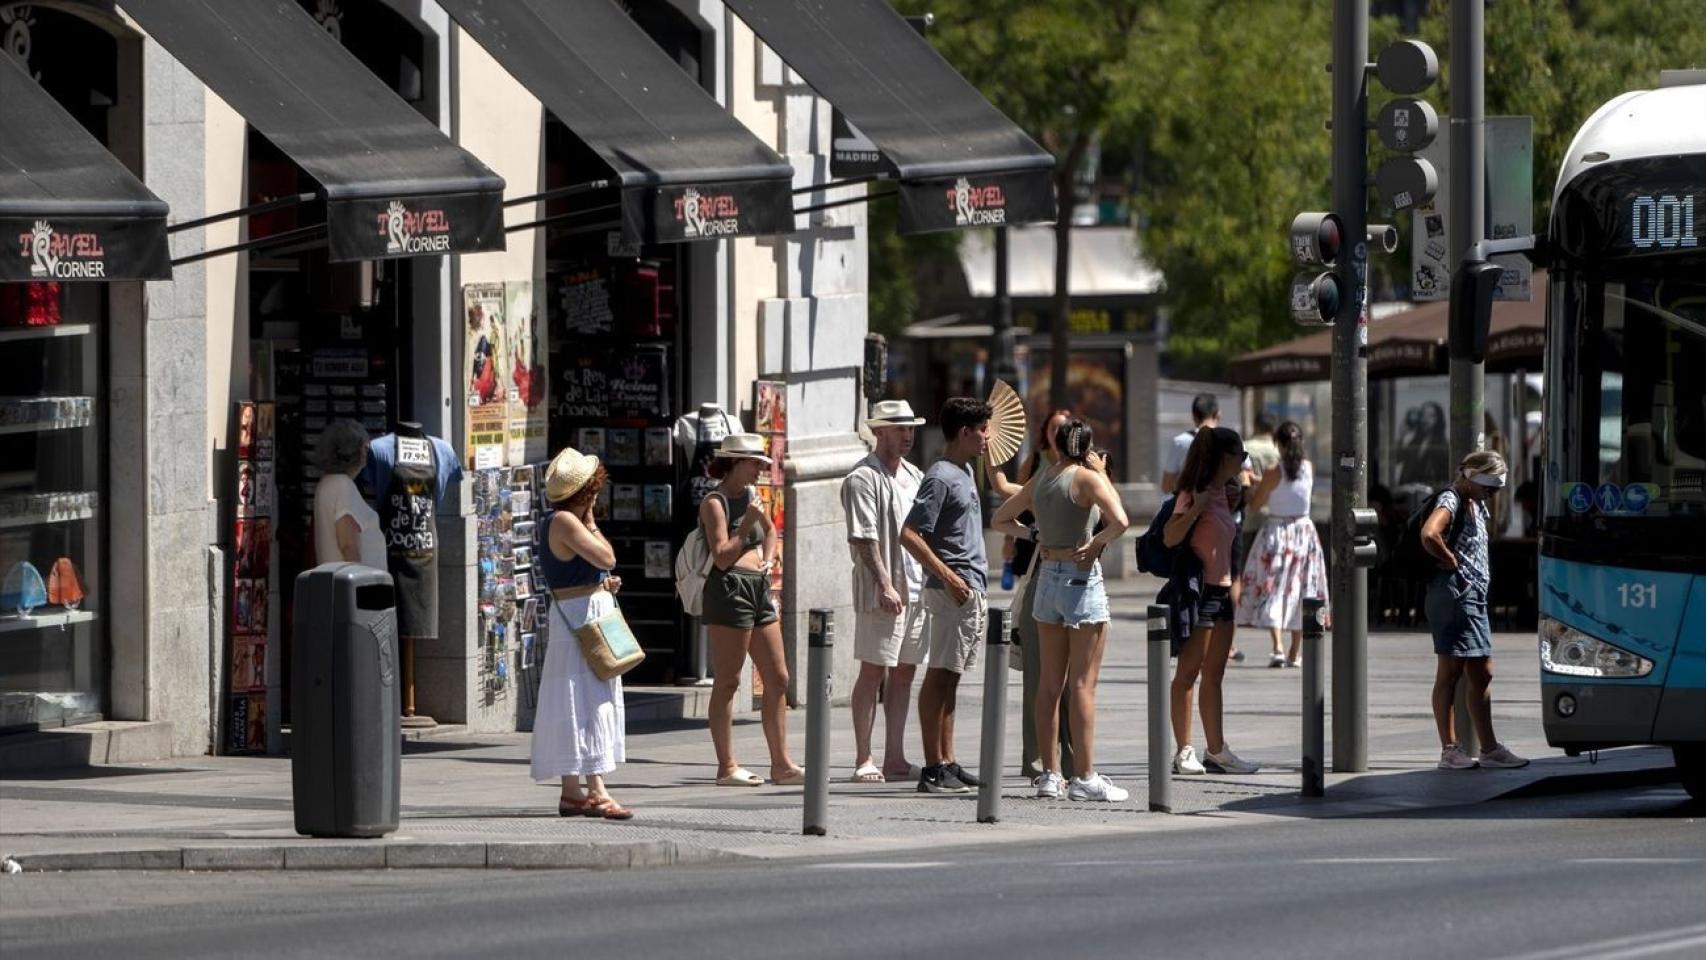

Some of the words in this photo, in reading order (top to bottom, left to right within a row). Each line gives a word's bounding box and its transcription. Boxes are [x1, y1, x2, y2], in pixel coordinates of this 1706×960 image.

[836, 152, 880, 162] MADRID
[972, 209, 1006, 225] CORNER
[1632, 195, 1698, 248] 001
[704, 218, 739, 236] CORNER
[407, 234, 450, 253] CORNER
[55, 261, 106, 278] CORNER
[391, 511, 409, 529] de
[1617, 583, 1656, 609] 131
